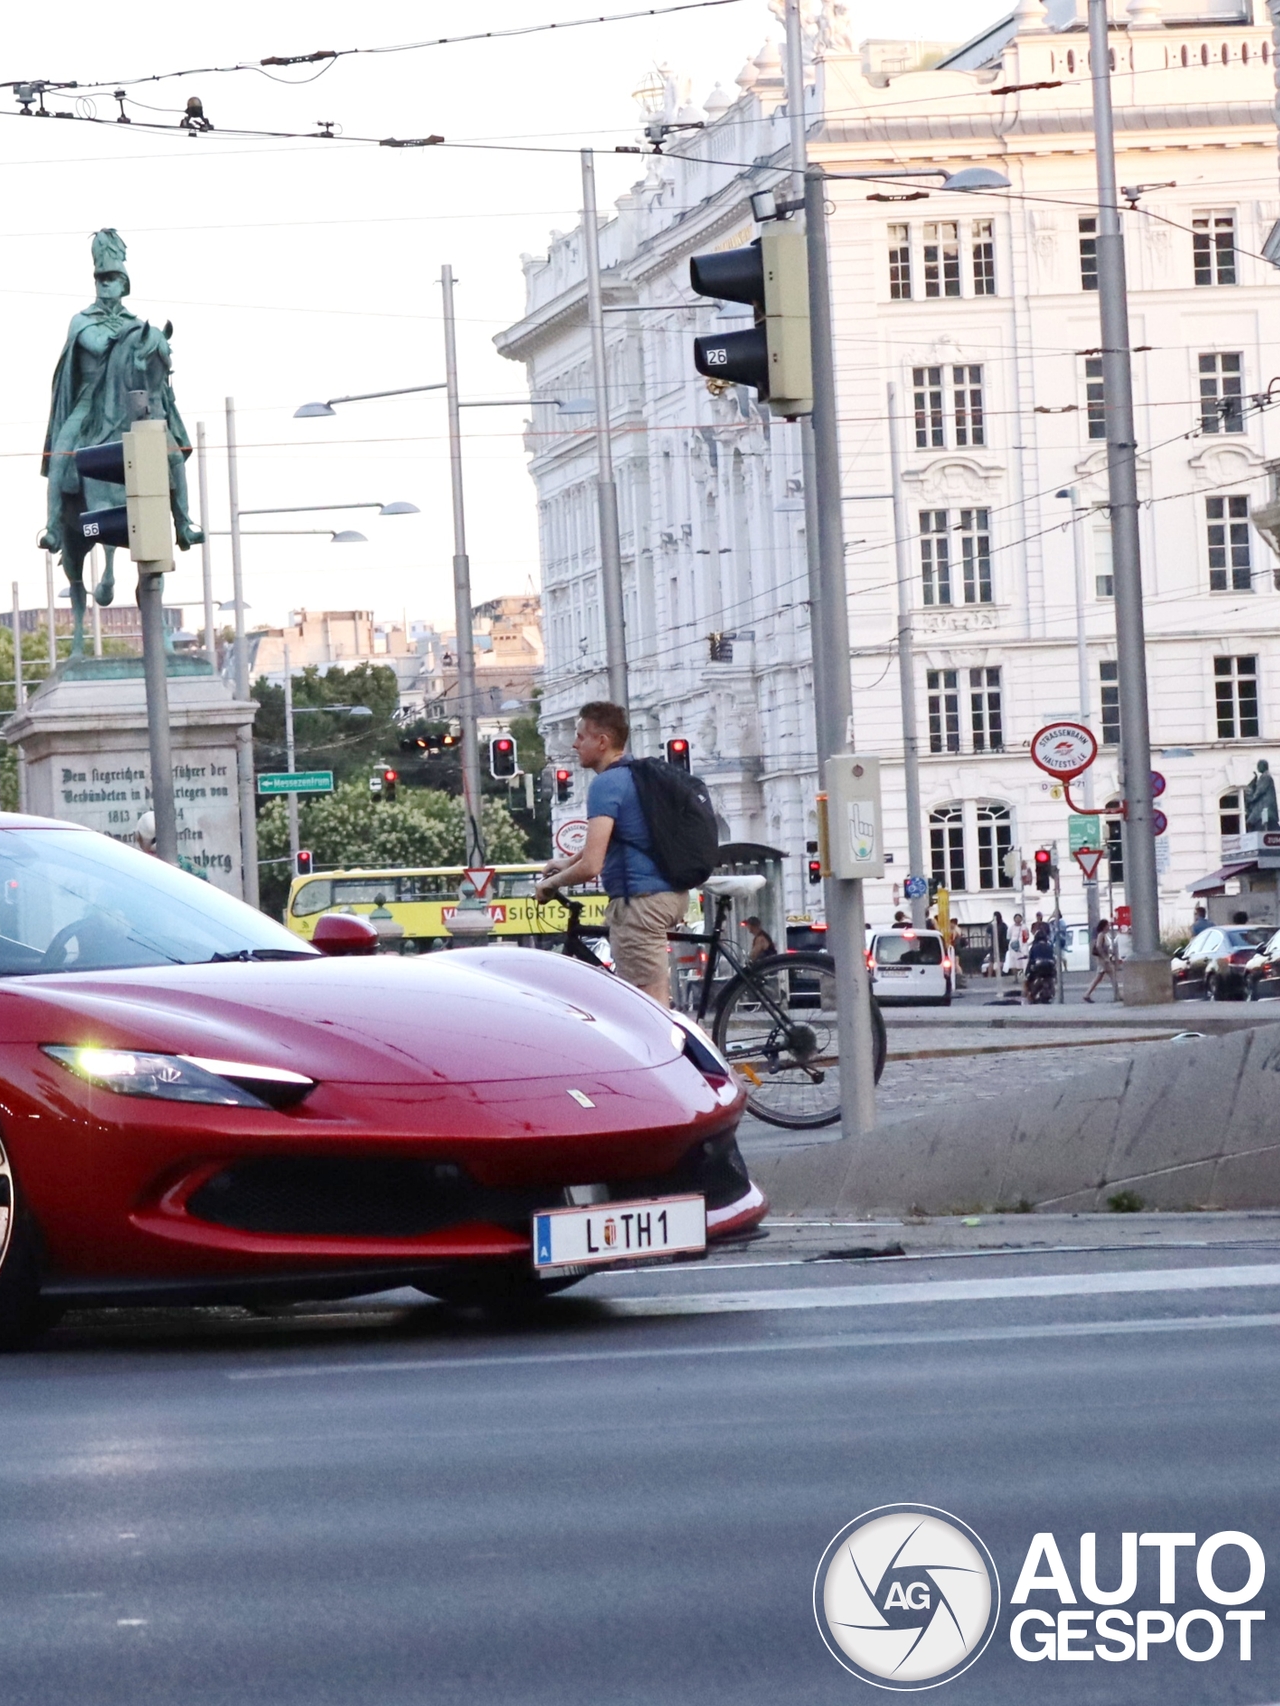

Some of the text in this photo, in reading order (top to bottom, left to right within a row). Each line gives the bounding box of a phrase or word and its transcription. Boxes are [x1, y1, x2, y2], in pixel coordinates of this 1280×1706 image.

[708, 350, 726, 364] 26
[84, 523, 99, 535] 56
[1039, 729, 1088, 747] STRASSENBAHN
[62, 768, 86, 784] Dem
[210, 762, 227, 776] der
[274, 777, 330, 788] Messezentrum
[174, 786, 207, 801] riegen
[210, 787, 228, 797] von
[108, 810, 130, 823] 1813
[586, 1218, 599, 1253] L
[540, 1246, 549, 1257] A
